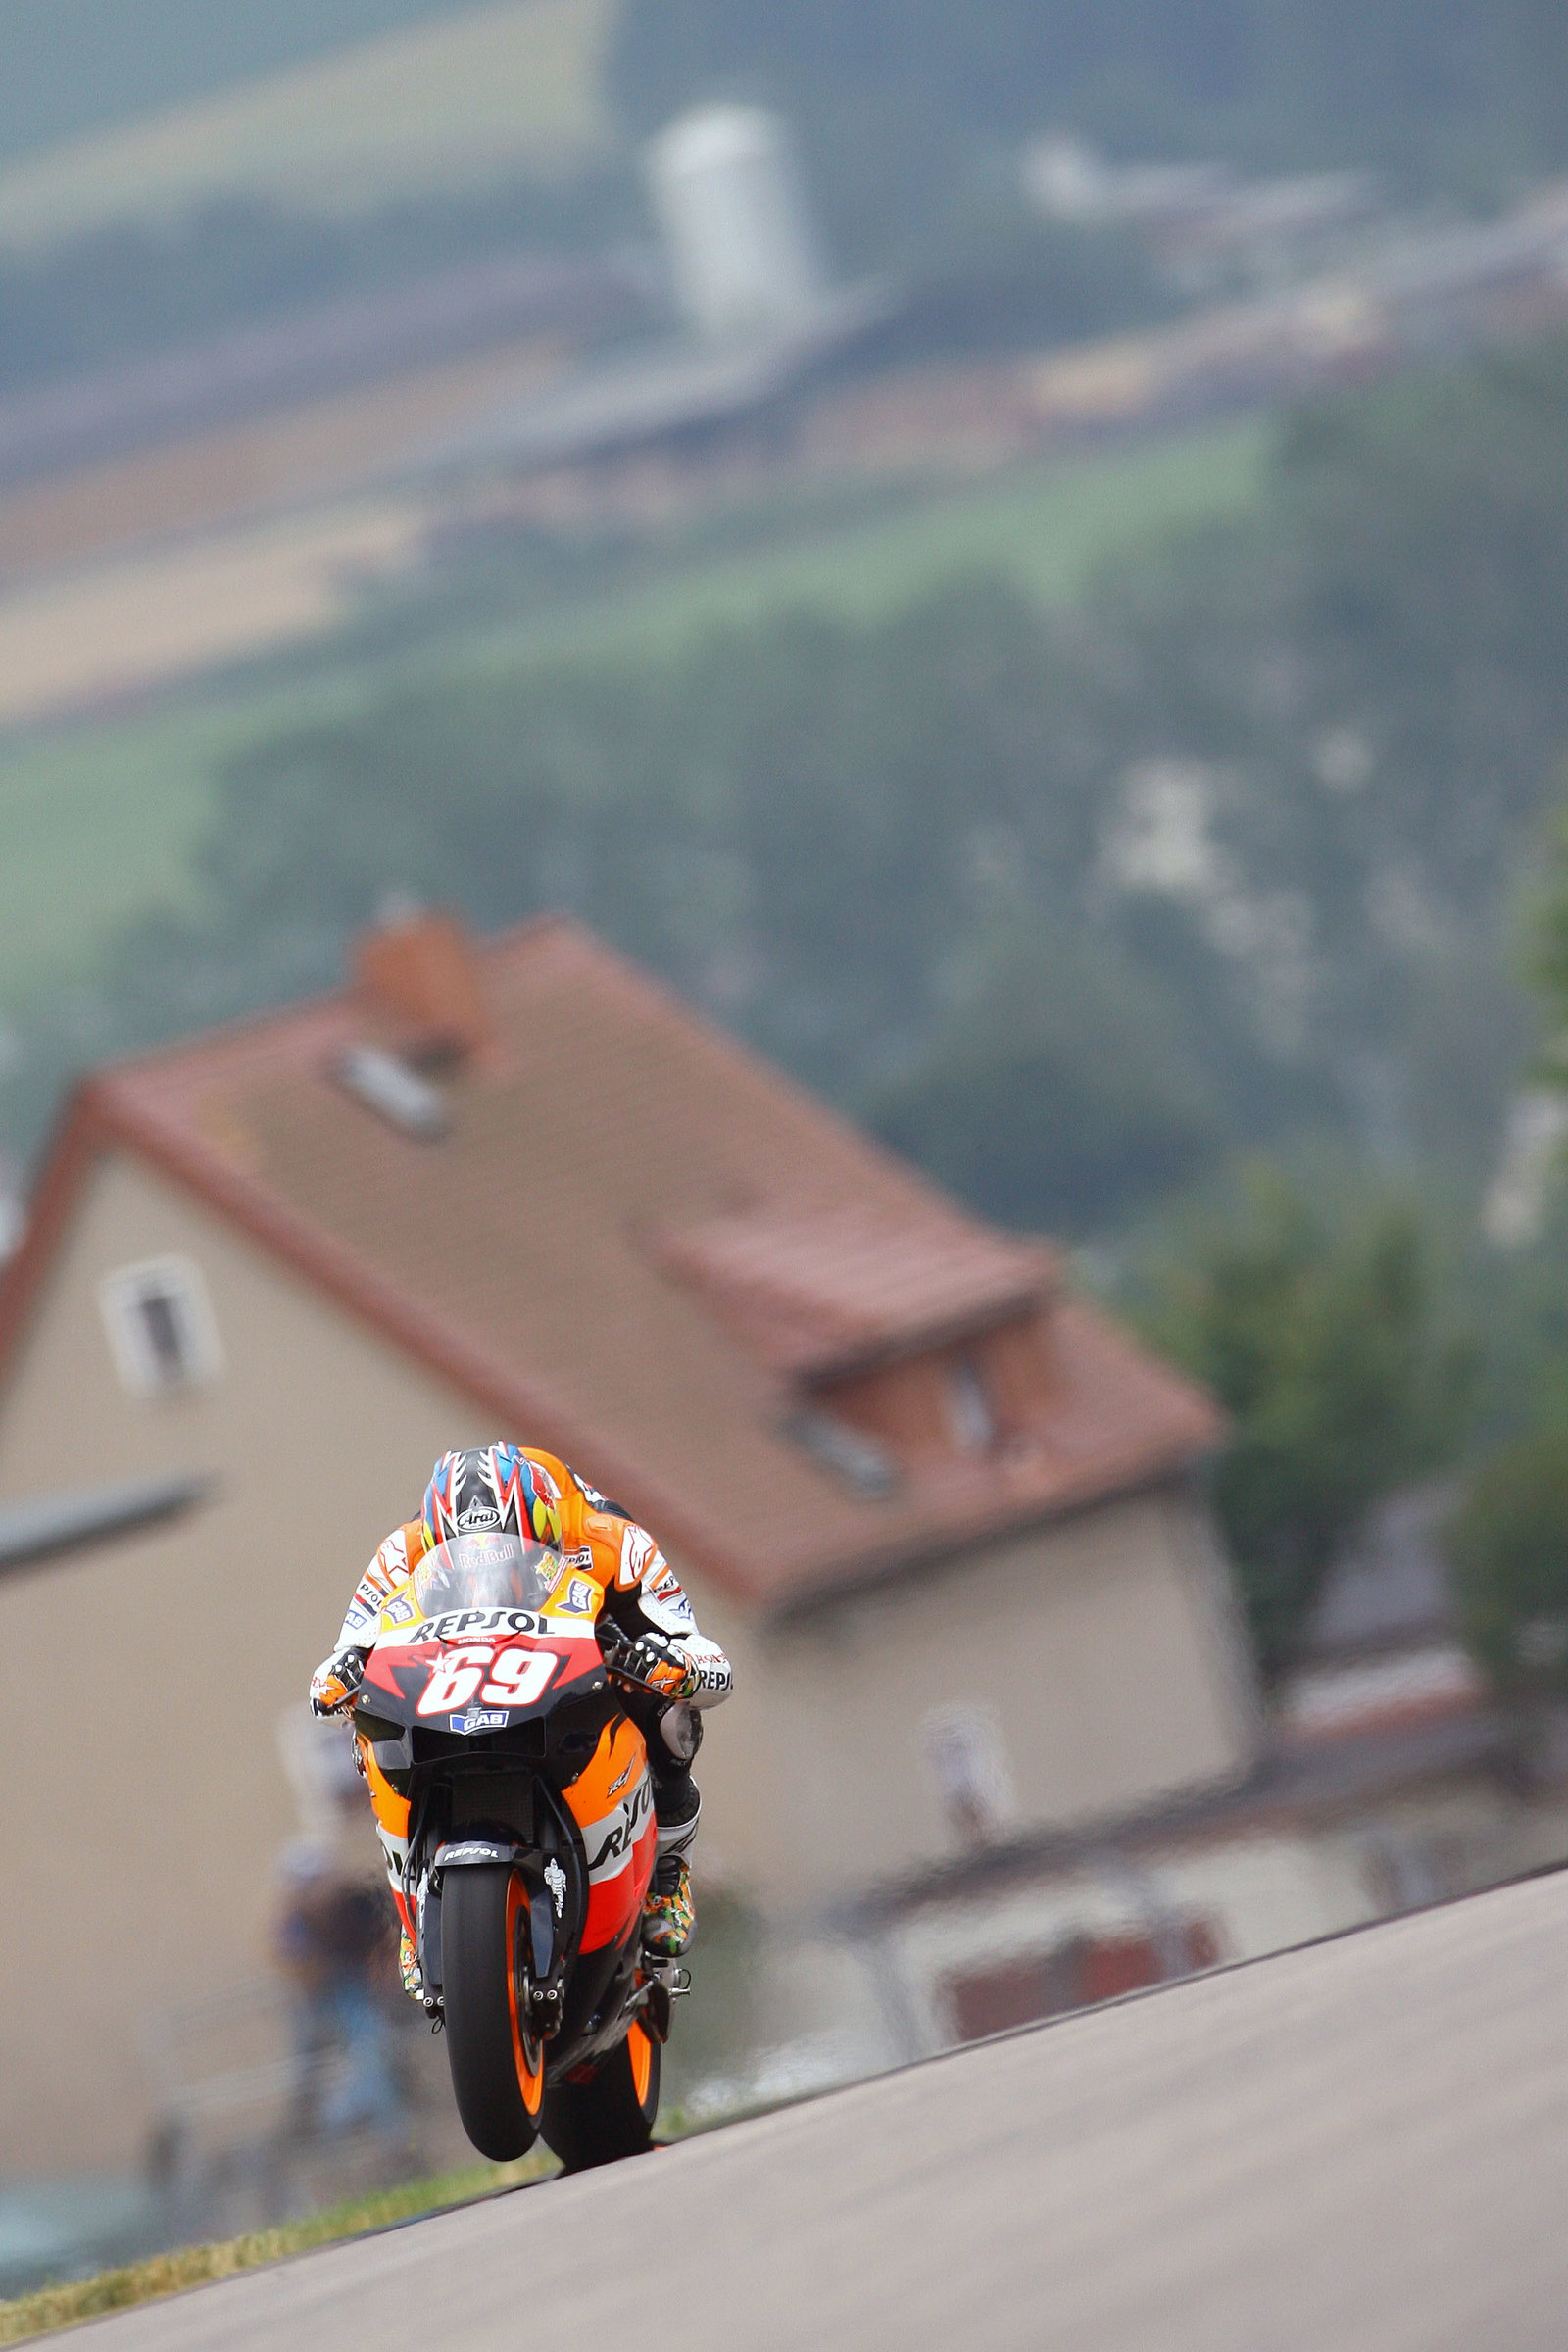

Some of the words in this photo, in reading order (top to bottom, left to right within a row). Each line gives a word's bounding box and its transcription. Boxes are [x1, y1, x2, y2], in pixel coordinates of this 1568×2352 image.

[460, 1510, 494, 1527] Arai
[459, 1552, 486, 1569] Red
[487, 1543, 514, 1564] Bull
[408, 1610, 556, 1644] REPSOL
[458, 1636, 497, 1644] HONDA
[416, 1644, 559, 1717] 69
[699, 1669, 734, 1691] REPS
[443, 1846, 499, 1862] REPSOL
